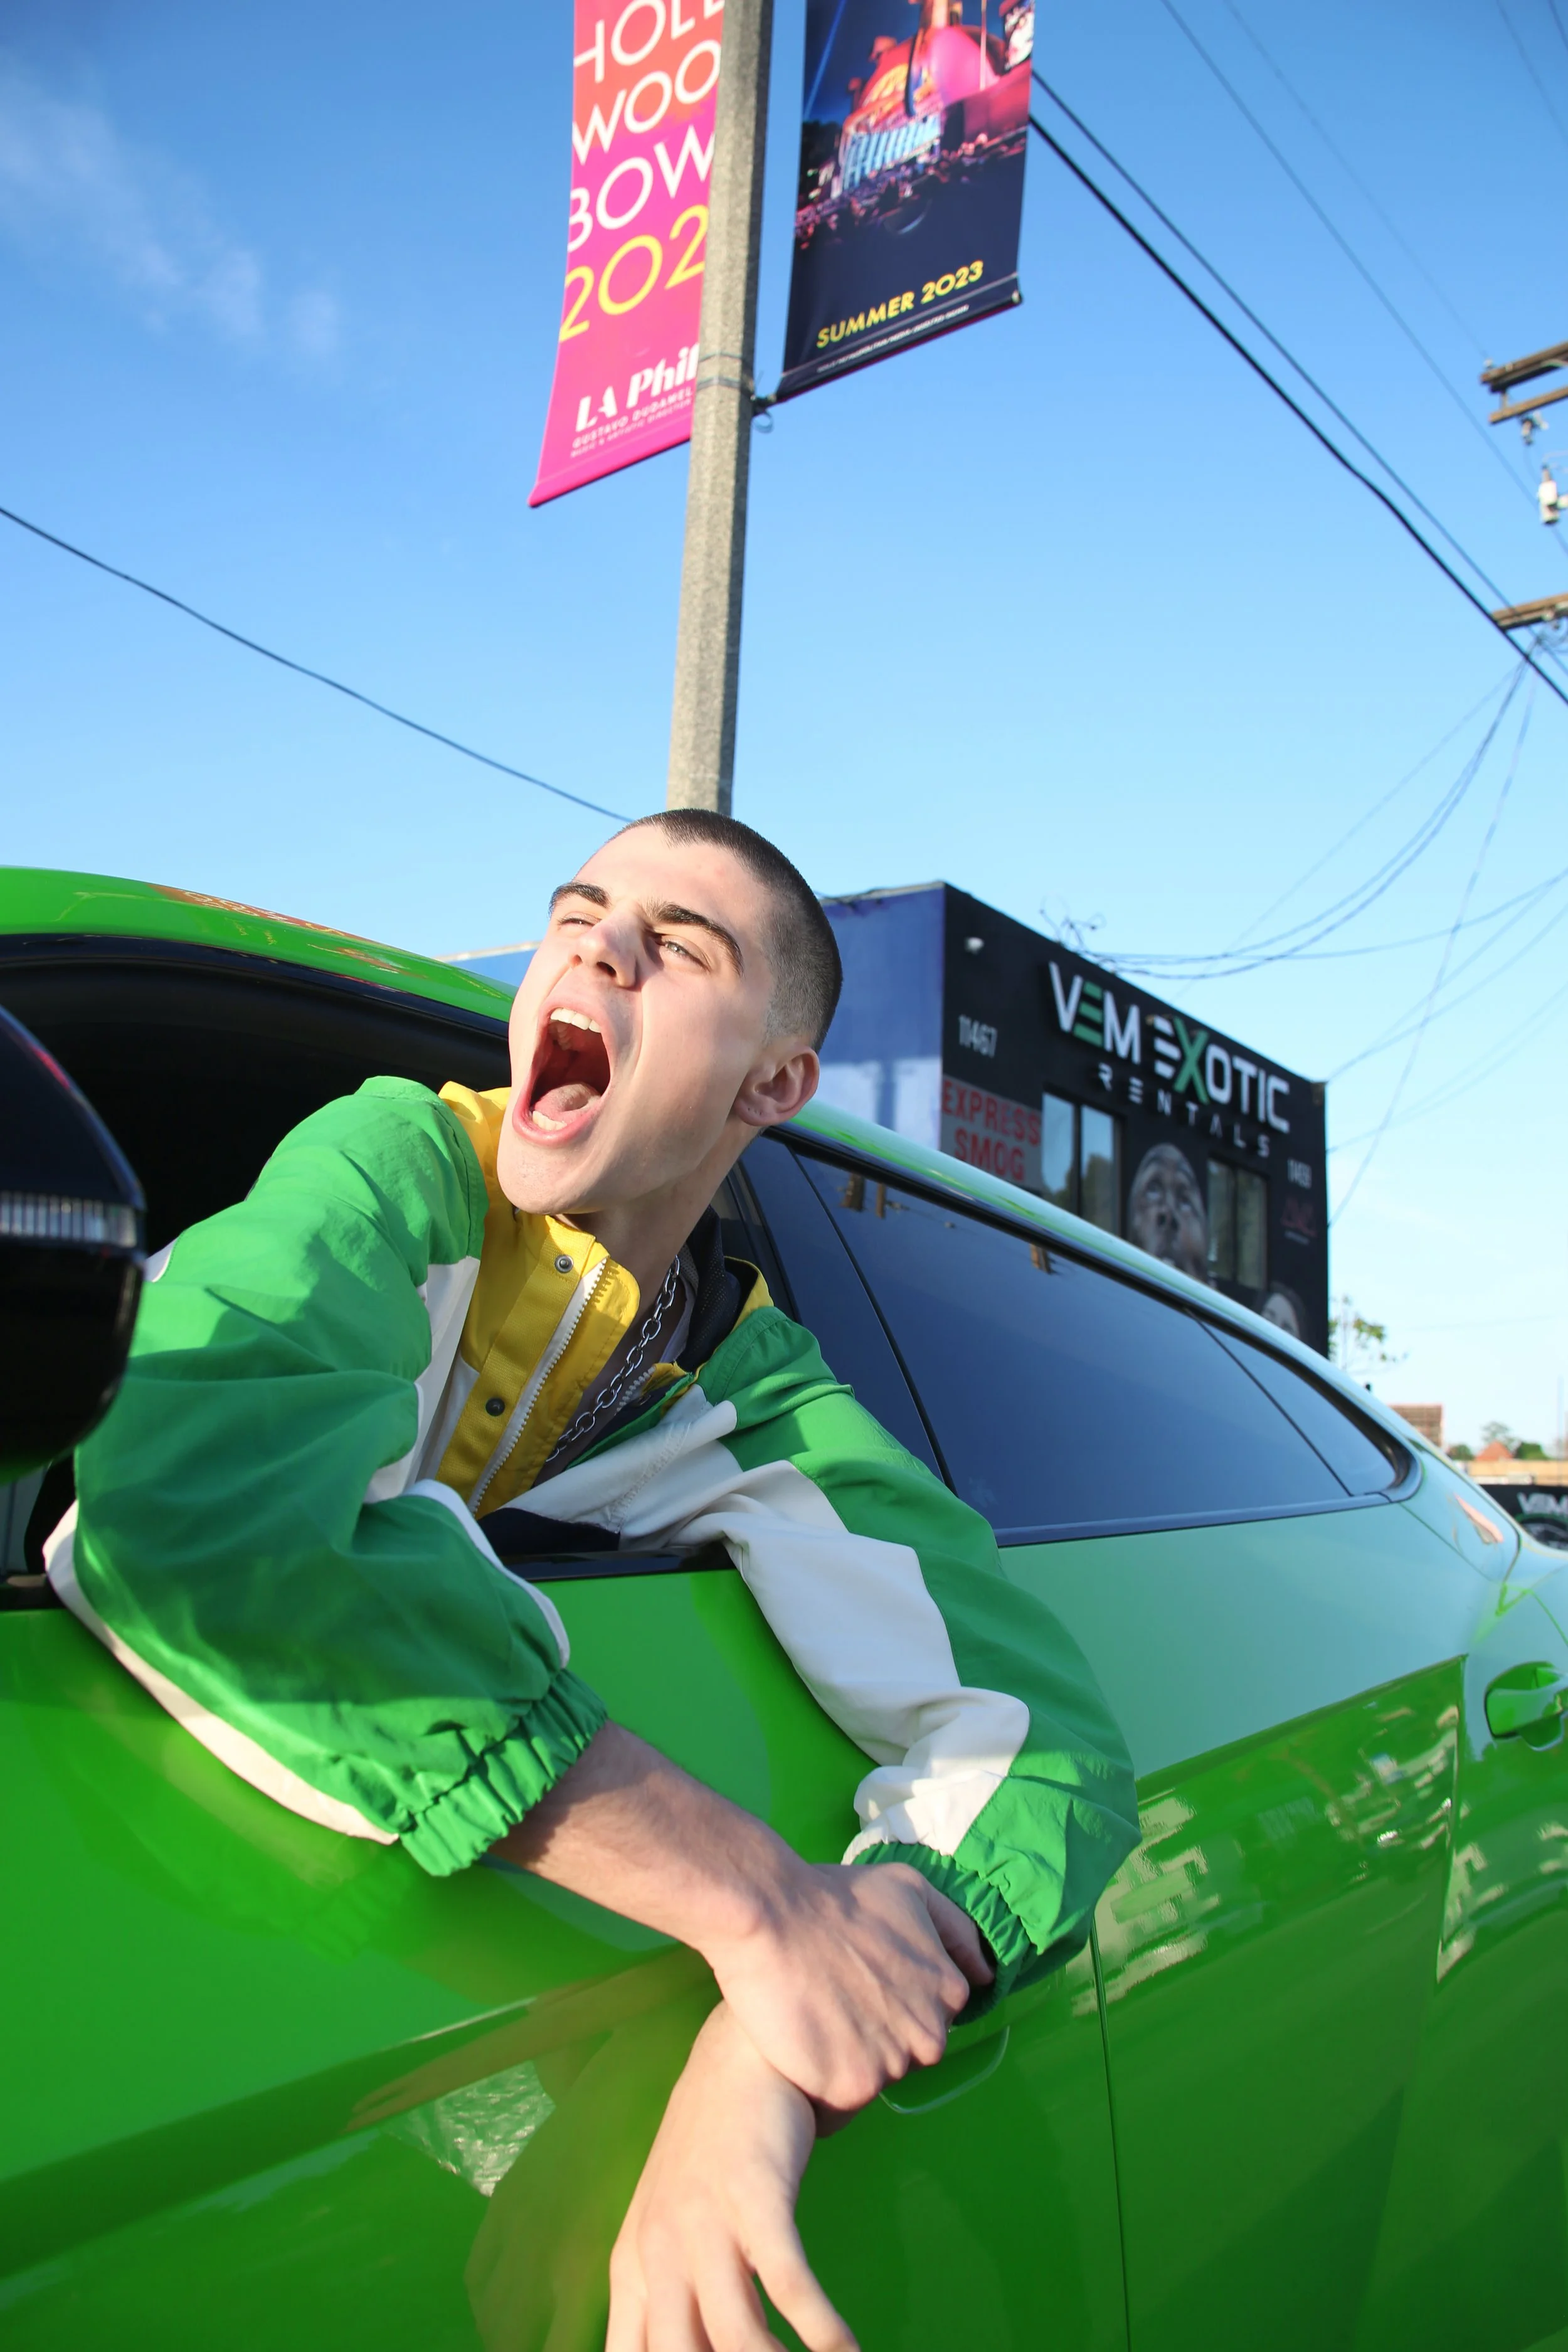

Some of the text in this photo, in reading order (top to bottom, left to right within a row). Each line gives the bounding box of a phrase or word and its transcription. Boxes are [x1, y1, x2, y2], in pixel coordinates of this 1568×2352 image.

[815, 290, 916, 349] SUMMER
[921, 259, 984, 304] 2023
[572, 387, 693, 449] GUSTAVO DUDAMEL
[575, 342, 700, 433] LA Phil
[1049, 960, 1290, 1134] VEM EXOTIC
[942, 1079, 1041, 1147] EXPRESS
[955, 1126, 1024, 1181] SMOG
[1098, 1062, 1269, 1158] RENTALS
